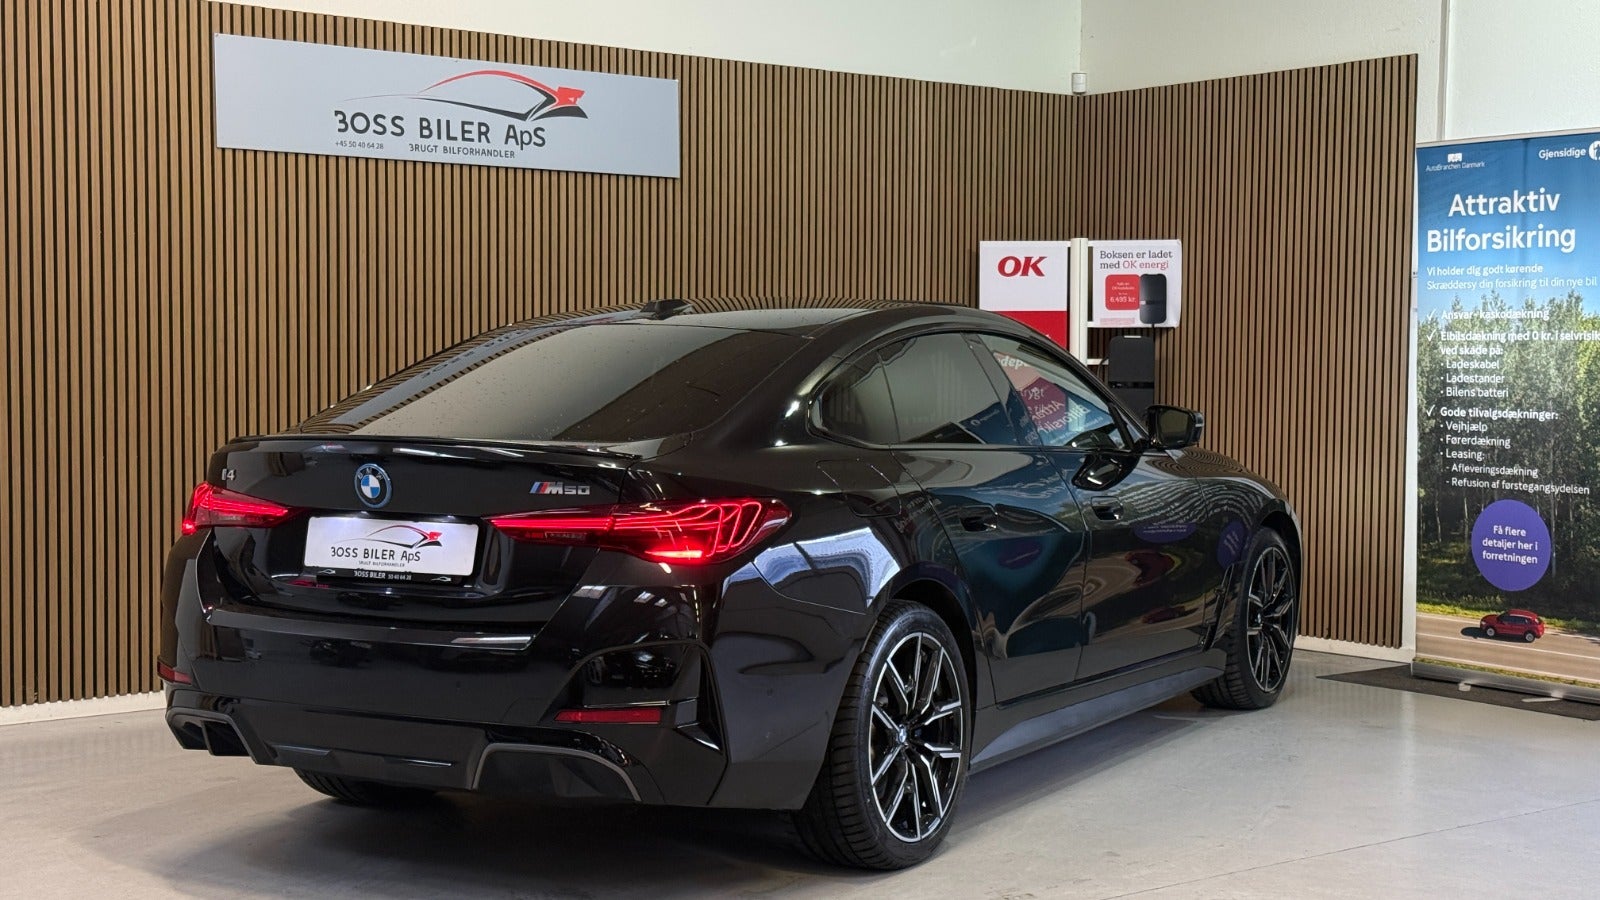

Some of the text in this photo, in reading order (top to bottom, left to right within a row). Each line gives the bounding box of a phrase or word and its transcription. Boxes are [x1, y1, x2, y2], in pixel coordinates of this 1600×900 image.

[419, 117, 491, 144] BILER
[504, 124, 546, 151] ApS
[335, 140, 348, 148] +45
[348, 140, 356, 148] 50
[358, 141, 366, 149] 40
[442, 145, 515, 159] BILFORHANDLER
[1538, 148, 1586, 160] Gjensidige
[1448, 187, 1561, 217] Attraktiv
[1427, 224, 1576, 254] Bilforsikring
[1100, 250, 1134, 259] Boksen
[1148, 250, 1174, 259] ladet
[998, 255, 1048, 278] OK
[1100, 260, 1169, 271] med OK energi
[1426, 264, 1543, 277] Vi holder dig godt kørende
[1427, 277, 1597, 291] Skræddersy din forsikring til din nye bil
[1480, 308, 1550, 321] kaskodækning
[1440, 330, 1506, 343] Elbilsdækning
[1508, 331, 1530, 341] med
[1532, 331, 1538, 340] 0
[1541, 330, 1553, 340] kr.
[1440, 346, 1458, 355] ved
[1460, 345, 1487, 355] skade
[1446, 360, 1500, 370] Ladeskabel
[1446, 374, 1505, 384] Ladestander
[1446, 387, 1508, 398] Bilens batteri
[1440, 406, 1559, 422] Gode tilvalgsdækninger:
[1446, 420, 1488, 434] Vejhjælp
[1446, 435, 1511, 450] Førerdækning
[1452, 464, 1538, 478] Afleveringsdækning
[545, 481, 590, 495] M50
[1452, 478, 1590, 495] Refusion af førstegangsydelsen
[1493, 525, 1526, 537] Få flere
[1482, 538, 1516, 550] detaljer
[1518, 540, 1533, 550] her
[363, 548, 395, 560] BILER
[400, 550, 421, 563] ApS
[1482, 550, 1538, 566] forretningen
